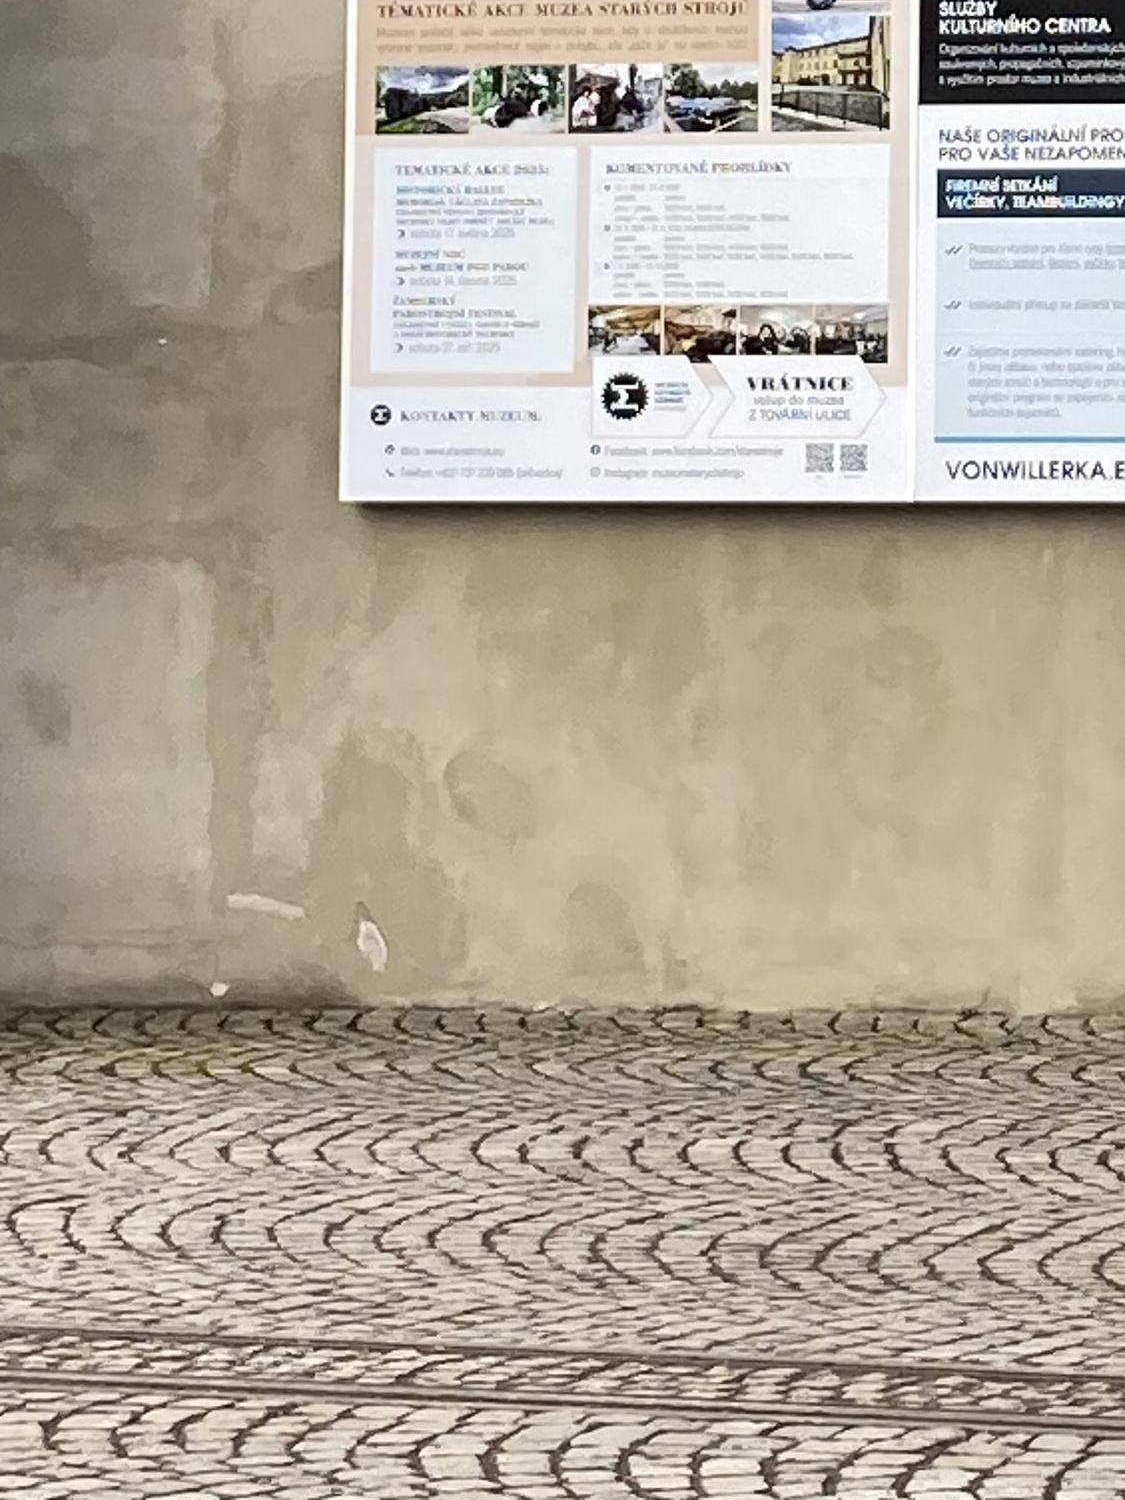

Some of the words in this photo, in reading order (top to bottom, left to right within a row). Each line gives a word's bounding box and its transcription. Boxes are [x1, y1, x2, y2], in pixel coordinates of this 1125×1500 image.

[485, 3, 526, 18] AKCE
[535, 3, 593, 17] MUZEA
[599, 0, 678, 17] STARÝCH
[938, 12, 1040, 35] KULTURNÍHO
[1044, 17, 1112, 34] CENTRA
[938, 125, 981, 144] NAŠE
[986, 124, 1088, 143] ORIGINÁLNÍ
[938, 146, 972, 162] PRO
[977, 142, 1020, 161] VAŠE
[475, 164, 512, 176] AKCE
[747, 372, 854, 392] VRÁTNICE
[789, 394, 804, 406] do
[748, 409, 757, 421] Z
